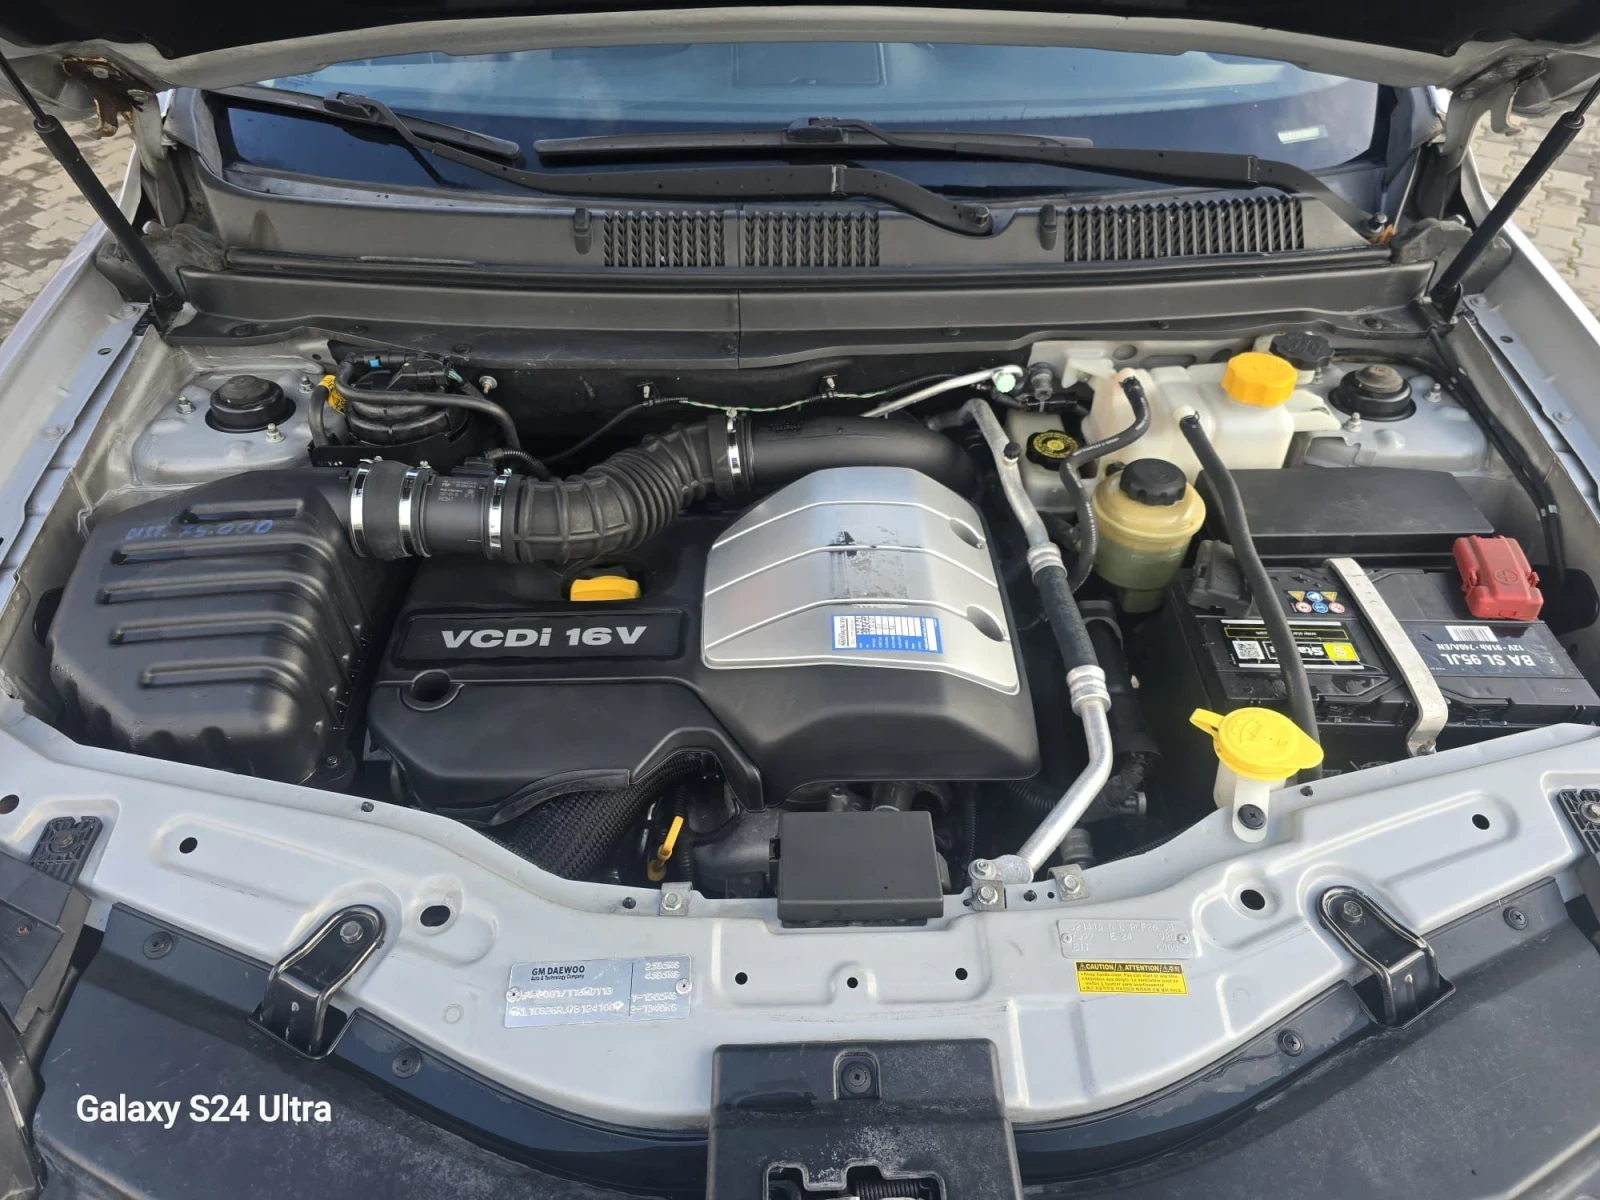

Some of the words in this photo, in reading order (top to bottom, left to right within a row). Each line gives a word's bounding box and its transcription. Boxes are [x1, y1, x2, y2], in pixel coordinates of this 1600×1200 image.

[441, 628, 552, 648] VCDi
[566, 626, 647, 646] 16V
[1508, 644, 1524, 652] 12V
[1441, 653, 1482, 665] 95JL
[1483, 654, 1504, 666] SL
[1506, 654, 1536, 666] BA
[532, 967, 546, 976] GM
[548, 965, 585, 975] DAEWOO
[1086, 963, 1114, 971] CAUTION
[1124, 964, 1160, 972] ATTENTION
